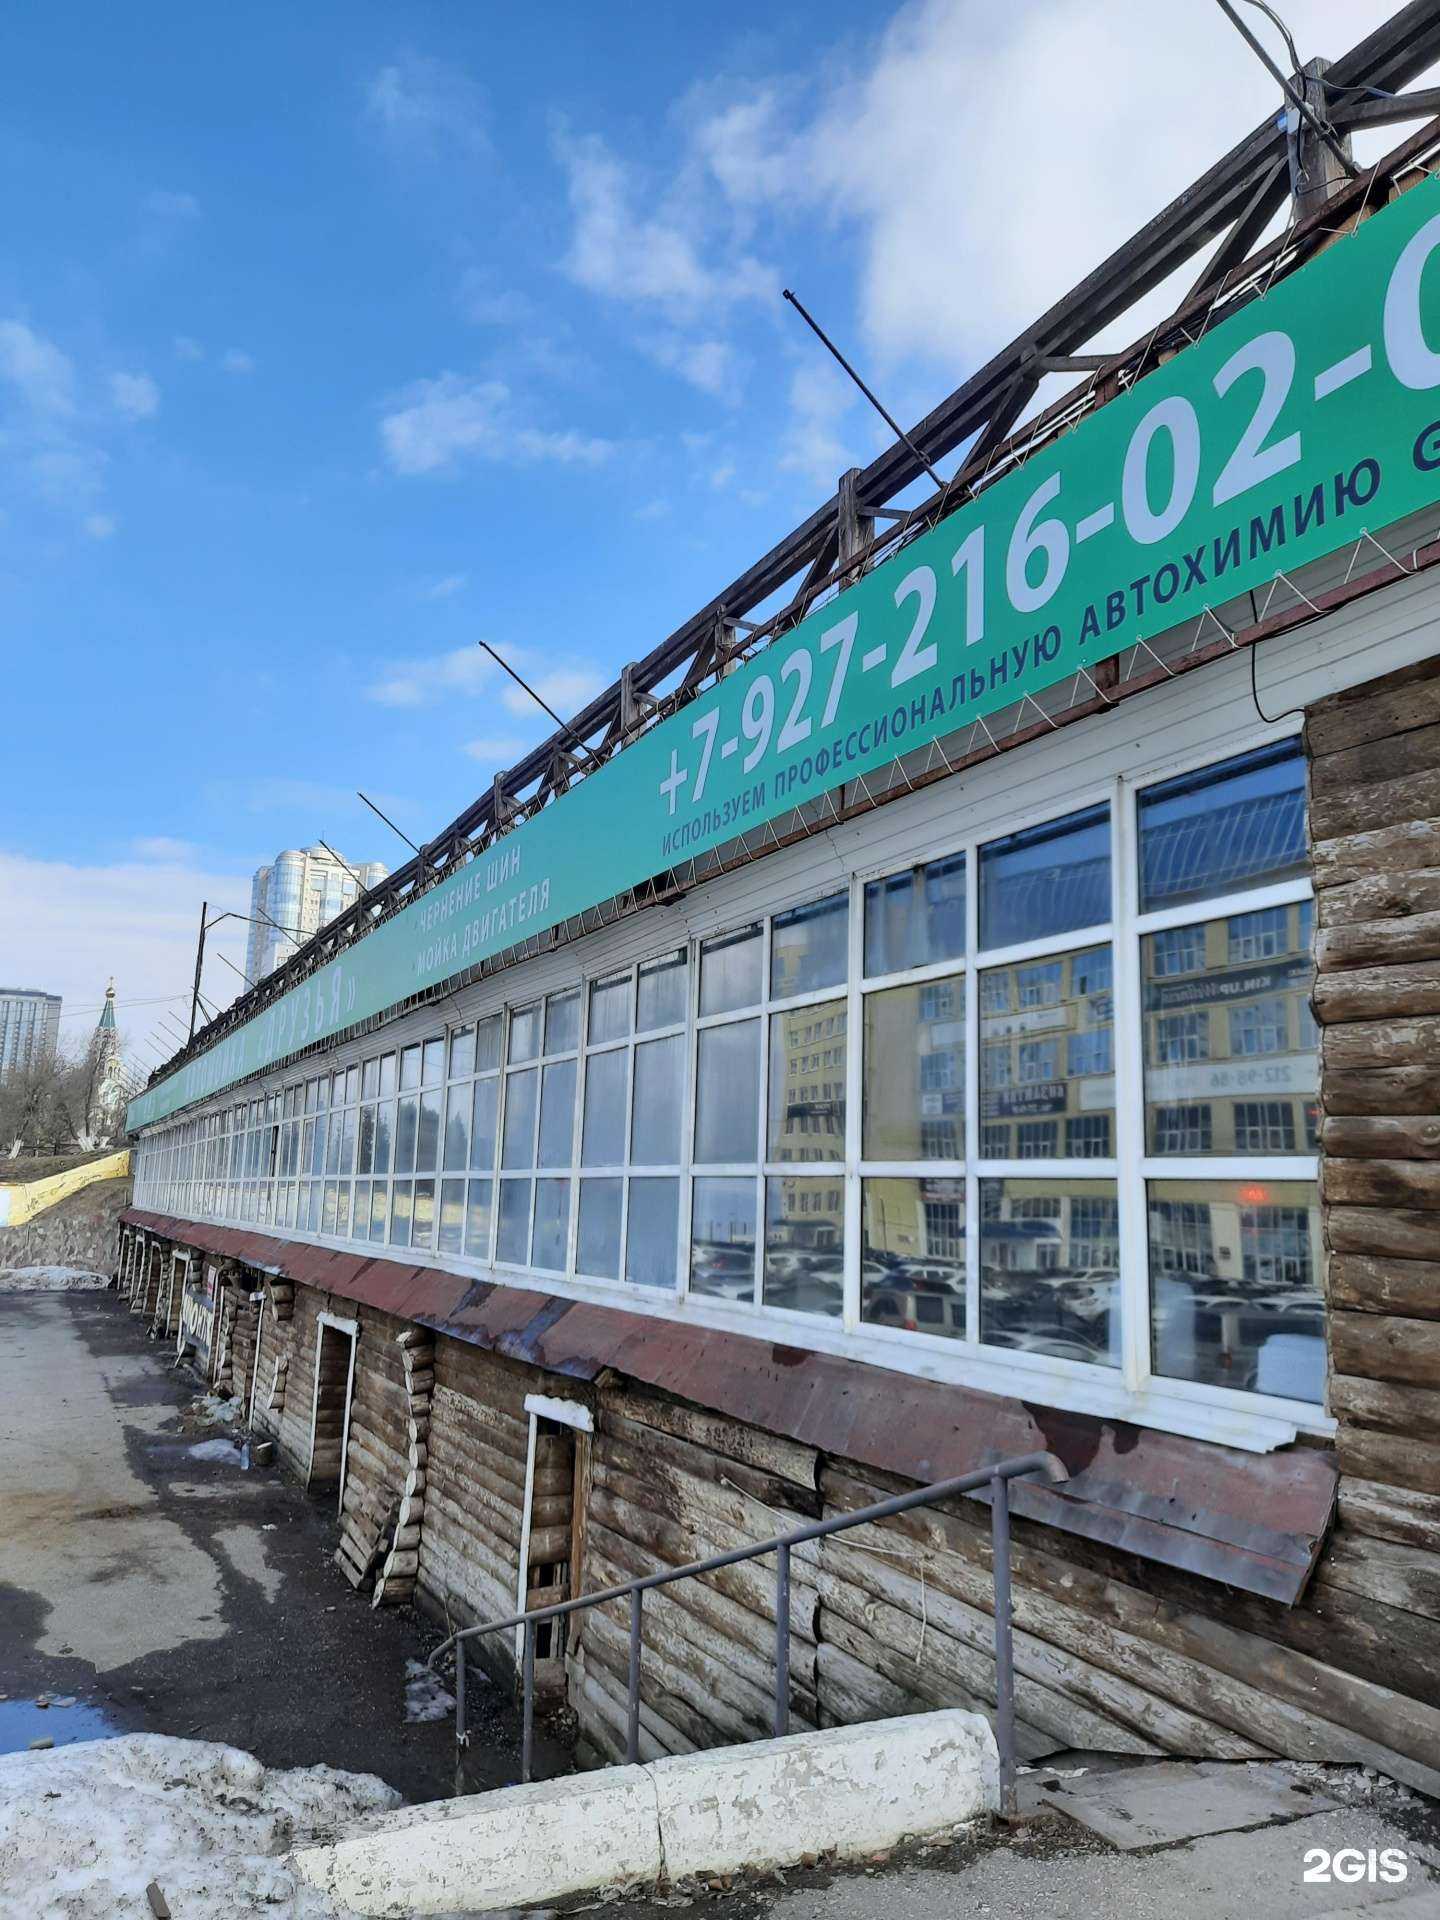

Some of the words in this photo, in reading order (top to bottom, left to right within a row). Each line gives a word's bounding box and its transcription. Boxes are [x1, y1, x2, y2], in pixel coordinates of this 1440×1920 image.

[662, 782, 766, 856] ИСПОЛЬЗУЕМ
[774, 624, 1061, 796] ПРОФЕССИОНАЛЬНУЮ
[1079, 457, 1382, 645] АВТОХИМИЮ
[416, 931, 457, 977] МОЙКА
[461, 878, 551, 958] ДВИГАТЕЛЯ
[419, 871, 481, 935] ЧЕРНЕНИЕ
[486, 844, 522, 893] ШИН
